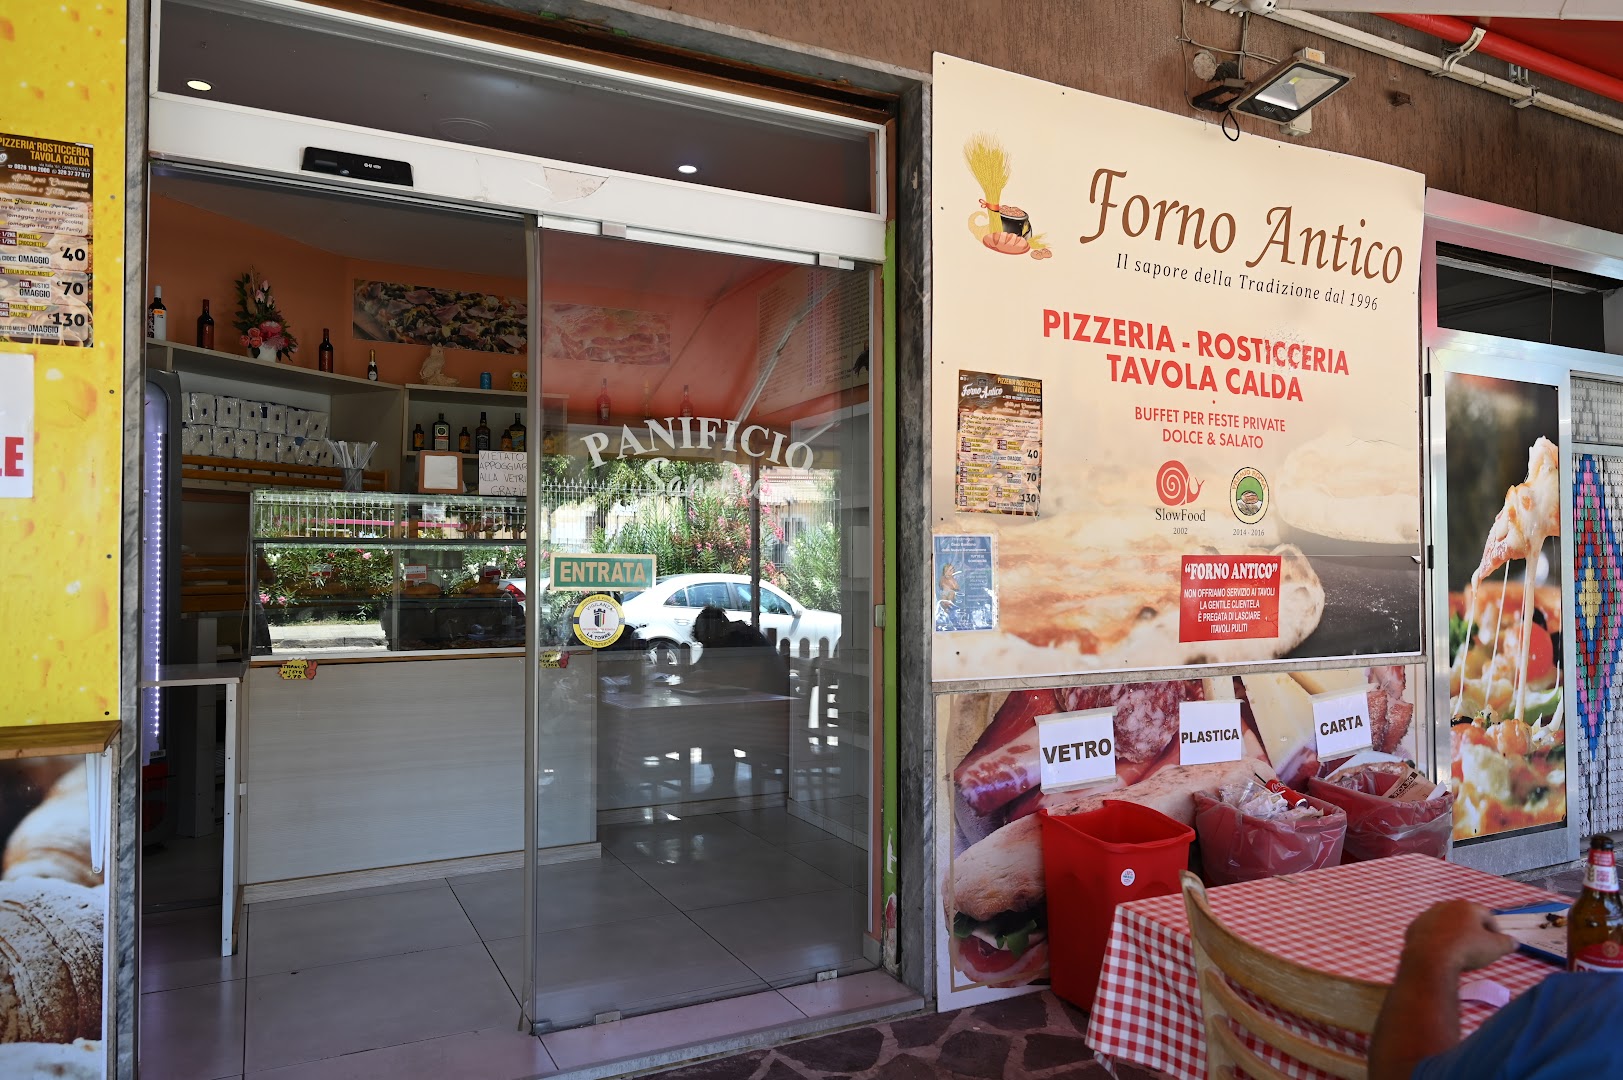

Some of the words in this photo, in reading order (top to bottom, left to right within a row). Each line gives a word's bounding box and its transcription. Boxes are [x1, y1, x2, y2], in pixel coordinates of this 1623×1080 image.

[37, 142, 90, 157] ROSTICCERIA
[30, 151, 61, 163] TAVOLA
[63, 155, 90, 167] CALDA
[1079, 168, 1237, 253] Forno
[1245, 205, 1403, 284] Antico
[18, 254, 50, 264] OMAGGIO
[1116, 253, 1129, 270] Il
[1134, 256, 1188, 280] sapore
[1194, 267, 1232, 287] della
[1238, 274, 1320, 300] Tradizione
[1324, 288, 1345, 304] dal
[1349, 291, 1378, 311] 1996
[20, 288, 51, 298] OMAGGIO
[28, 324, 59, 334] OMAGGIO
[1043, 308, 1176, 353] PIZZERIA
[1197, 330, 1350, 376] ROSTICCERIA
[1106, 353, 1218, 392] TAVOLA
[1225, 367, 1304, 402] CALDA
[1135, 406, 1180, 424] BUFFET
[1183, 410, 1205, 426] PER
[1208, 413, 1239, 428] FESTE
[1243, 416, 1286, 432] PRIVATE
[580, 416, 815, 471] PANIFICIO
[1162, 428, 1203, 445] DOLCE
[1206, 432, 1216, 446] &
[1219, 433, 1264, 449] SALATO
[480, 451, 525, 461] VIETATO
[480, 472, 498, 482] ALLA
[1155, 507, 1206, 522] SlowFood
[1173, 527, 1188, 535] 2002
[1232, 528, 1247, 536] 2014
[560, 561, 647, 583] ENTRATA
[1184, 588, 1196, 598] NON
[1197, 588, 1226, 598] OFFRIAMO
[1226, 587, 1250, 597] SERVIZIO
[1251, 587, 1257, 597] AI
[1257, 587, 1275, 597] TAVOLI
[1199, 601, 1207, 610] LA
[1208, 600, 1231, 610] GENTILE
[1231, 599, 1260, 609] CLIENTELA
[1197, 610, 1202, 622] È
[1203, 611, 1228, 622] PREGATA
[1228, 611, 1234, 621] DI
[1234, 610, 1261, 620] LASCIARE
[1231, 623, 1248, 633] PULITI
[1319, 714, 1363, 736] CARTA
[1181, 728, 1240, 744] PLASTICA
[1042, 738, 1112, 765] VETRO
